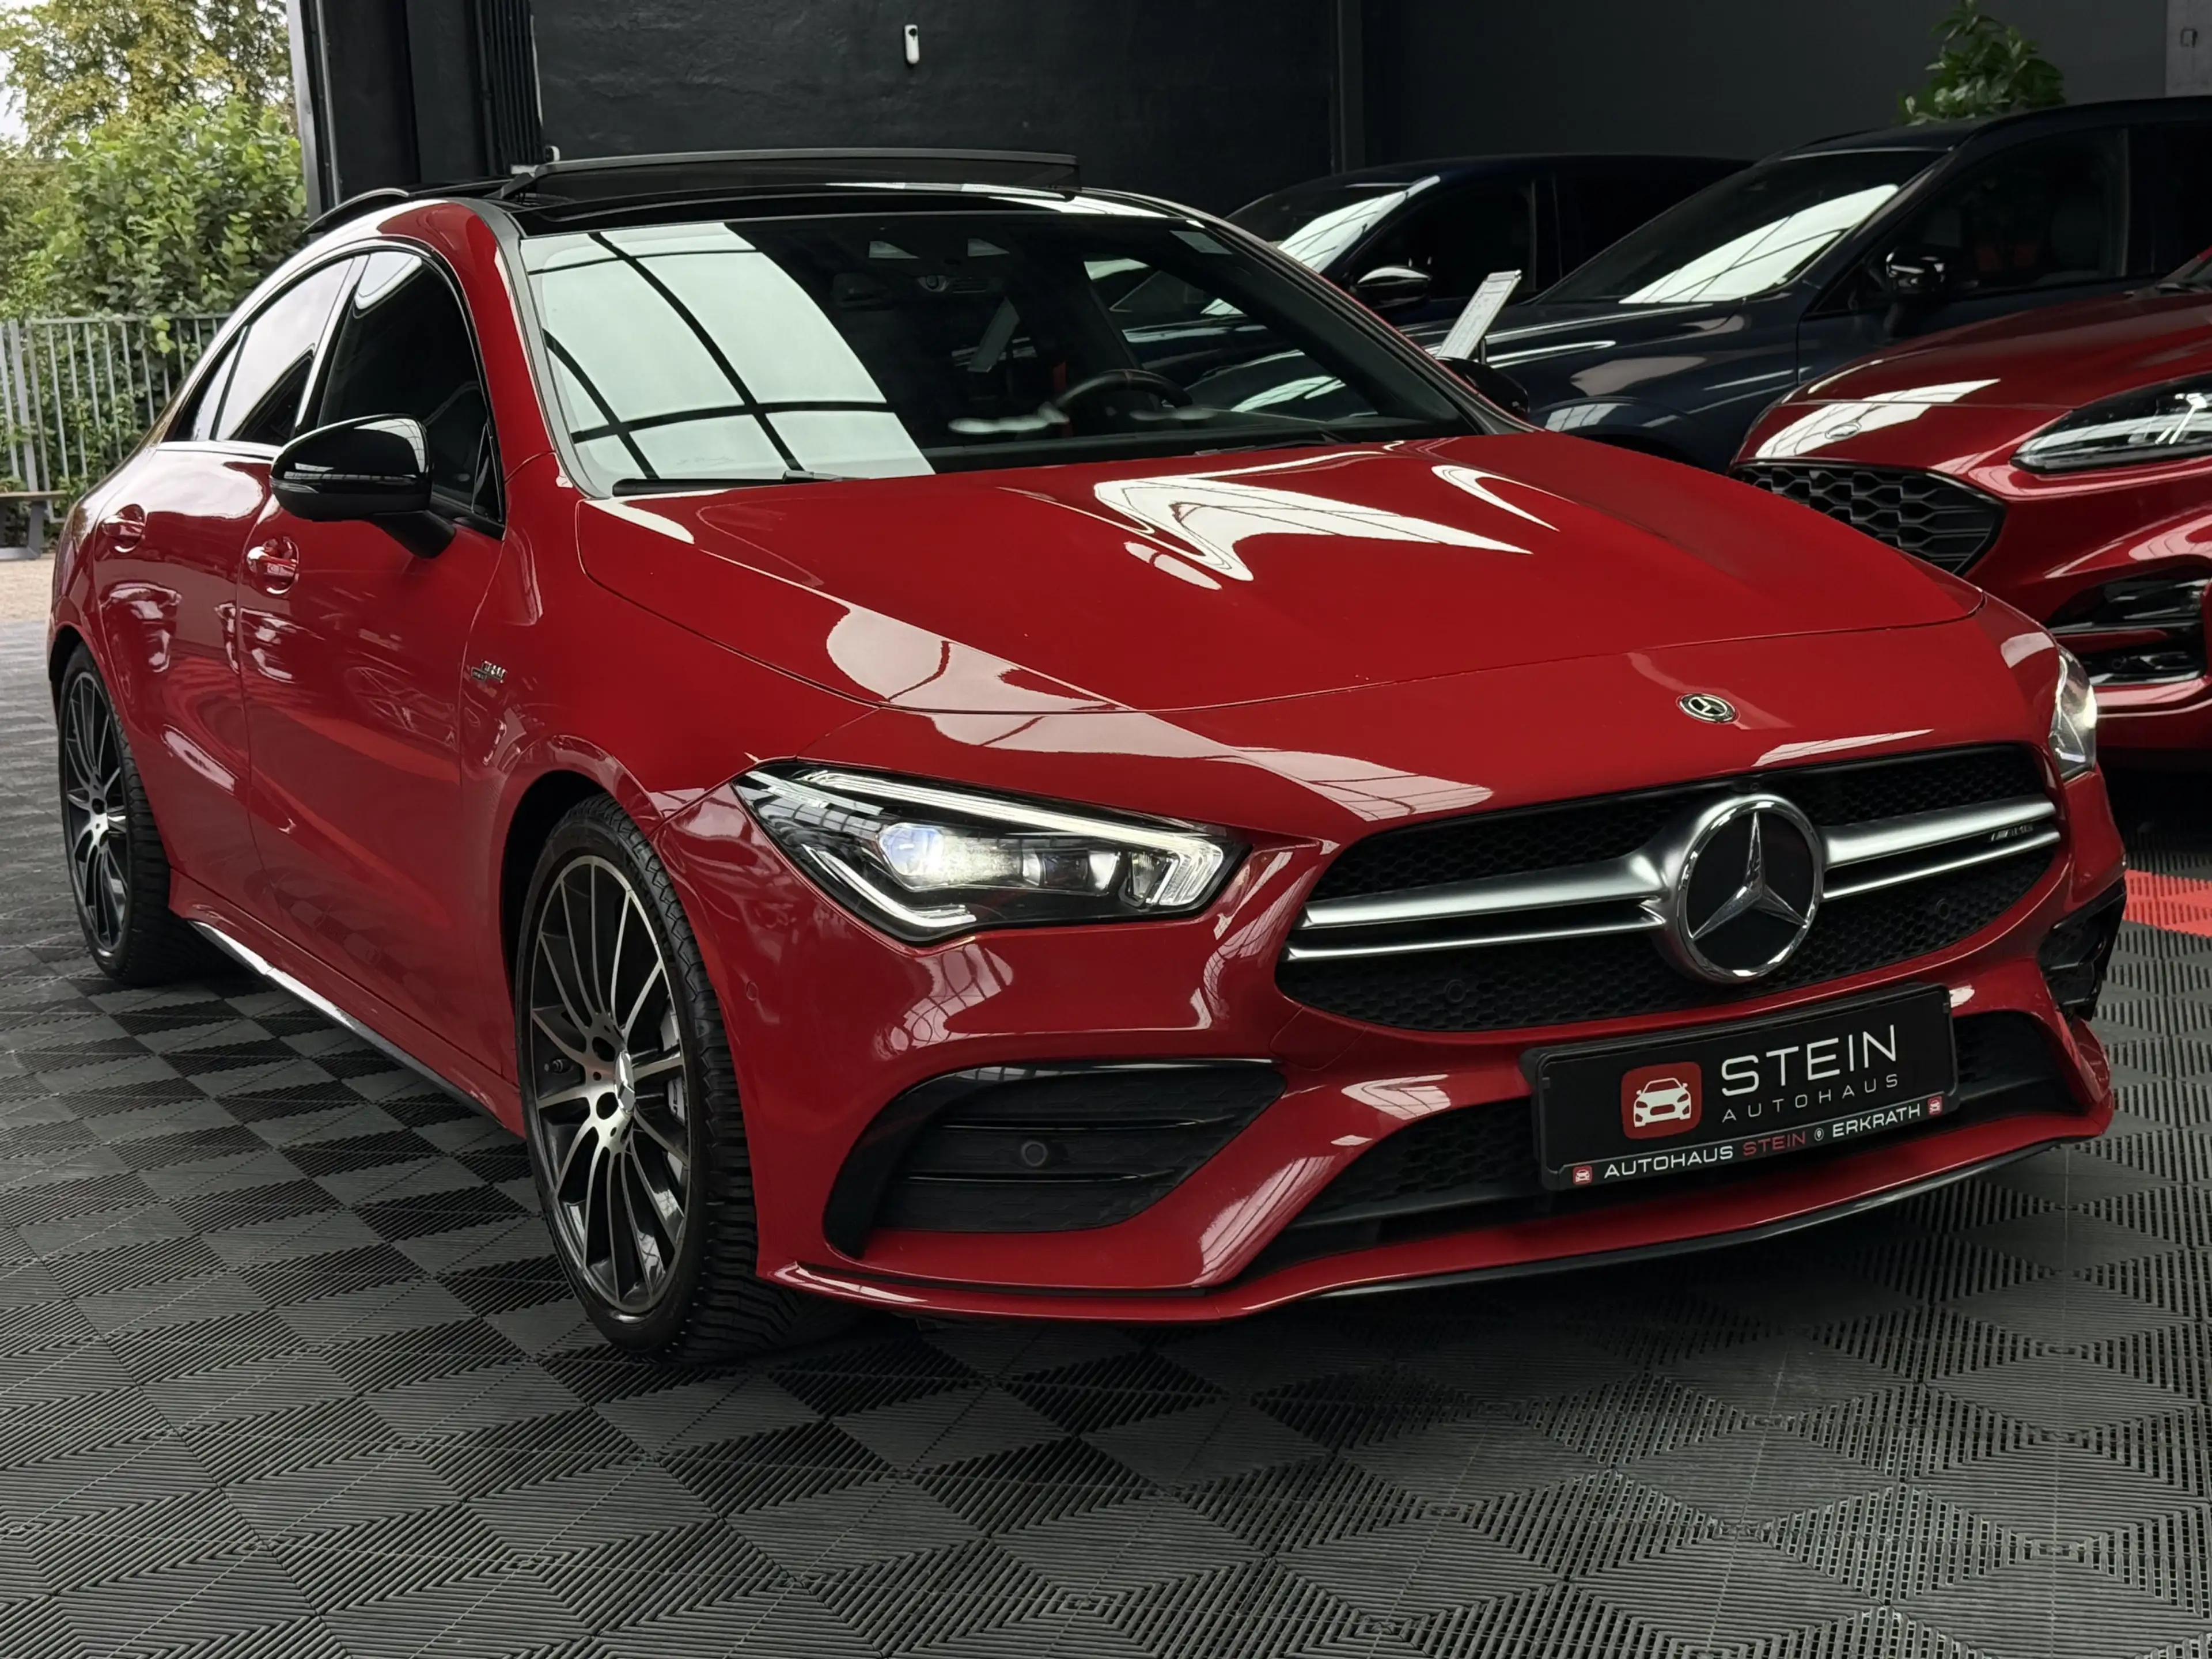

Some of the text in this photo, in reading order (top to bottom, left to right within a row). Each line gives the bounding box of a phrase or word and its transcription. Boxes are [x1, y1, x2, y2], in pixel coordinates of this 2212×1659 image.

[1721, 1024, 1896, 1097] STEIN
[1722, 1073, 1897, 1123] AUTOHAUS
[1604, 1103, 1921, 1179] AUTOHAUS STEIN ERKRATH
